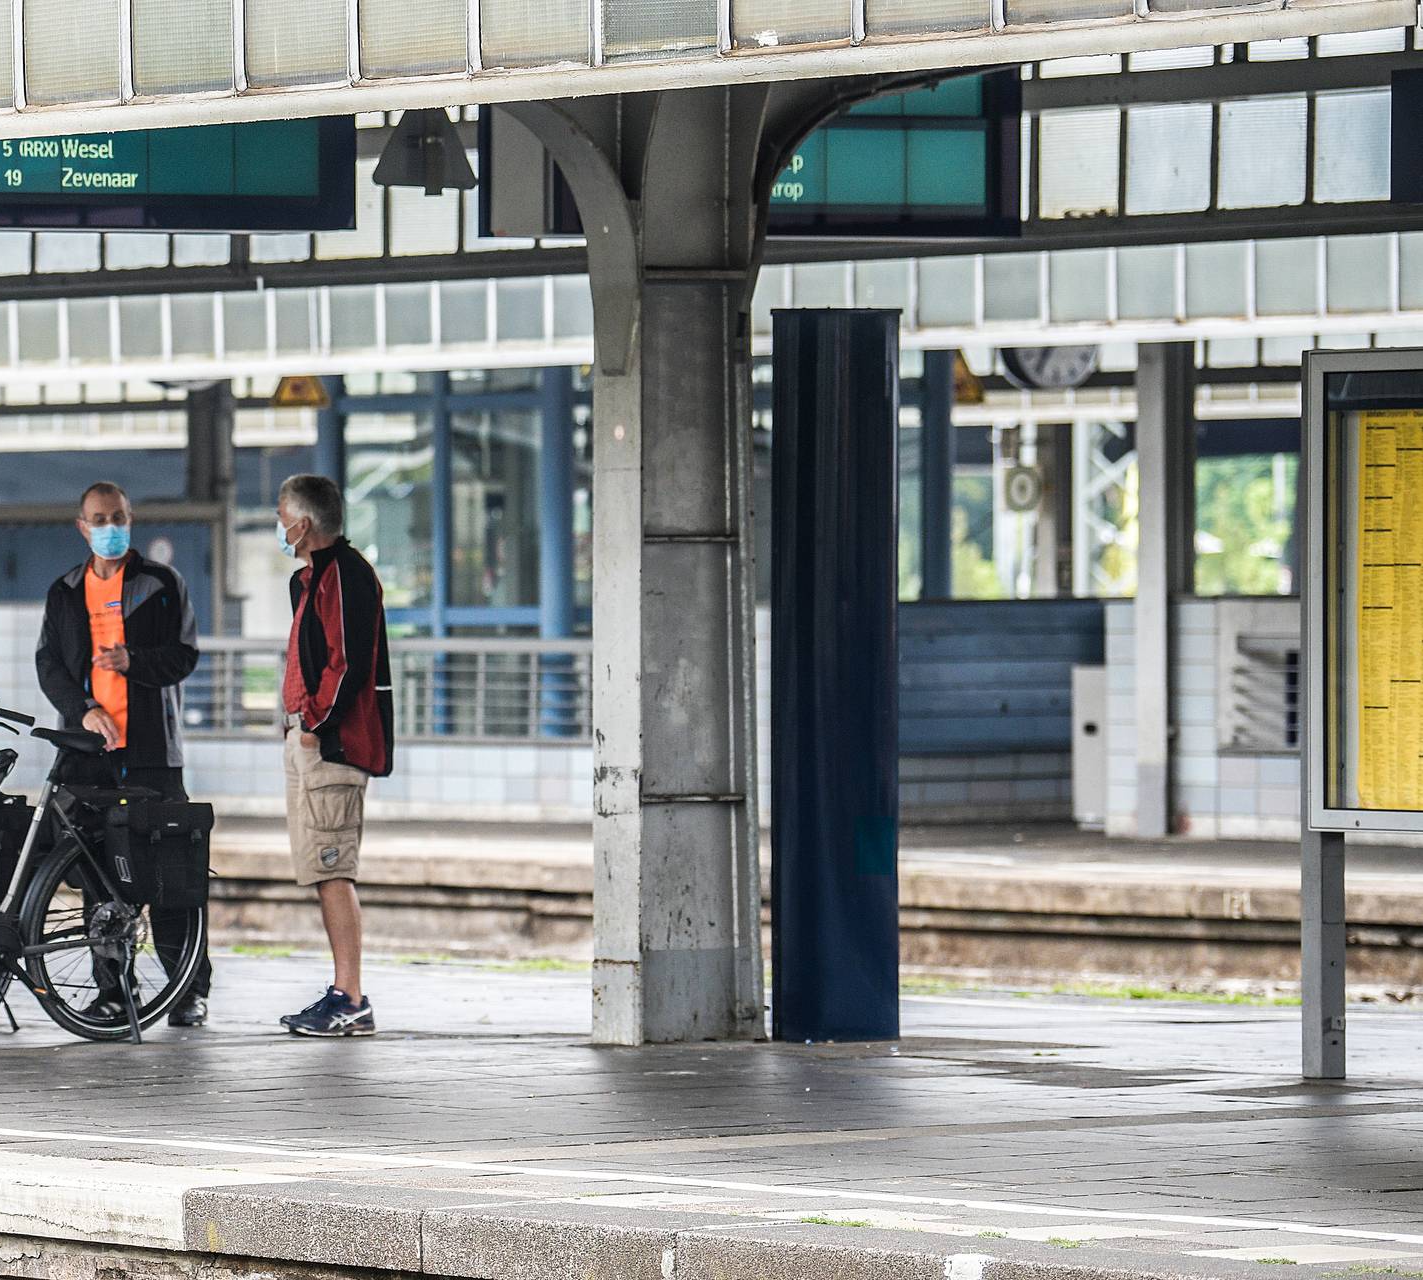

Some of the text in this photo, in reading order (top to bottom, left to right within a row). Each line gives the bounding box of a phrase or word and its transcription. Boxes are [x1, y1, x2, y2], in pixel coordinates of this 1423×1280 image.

[2, 140, 12, 157] 5
[19, 140, 58, 158] (RRX)
[61, 139, 114, 158] Wesel
[4, 169, 22, 186] 19
[61, 167, 138, 188] Zevenaar
